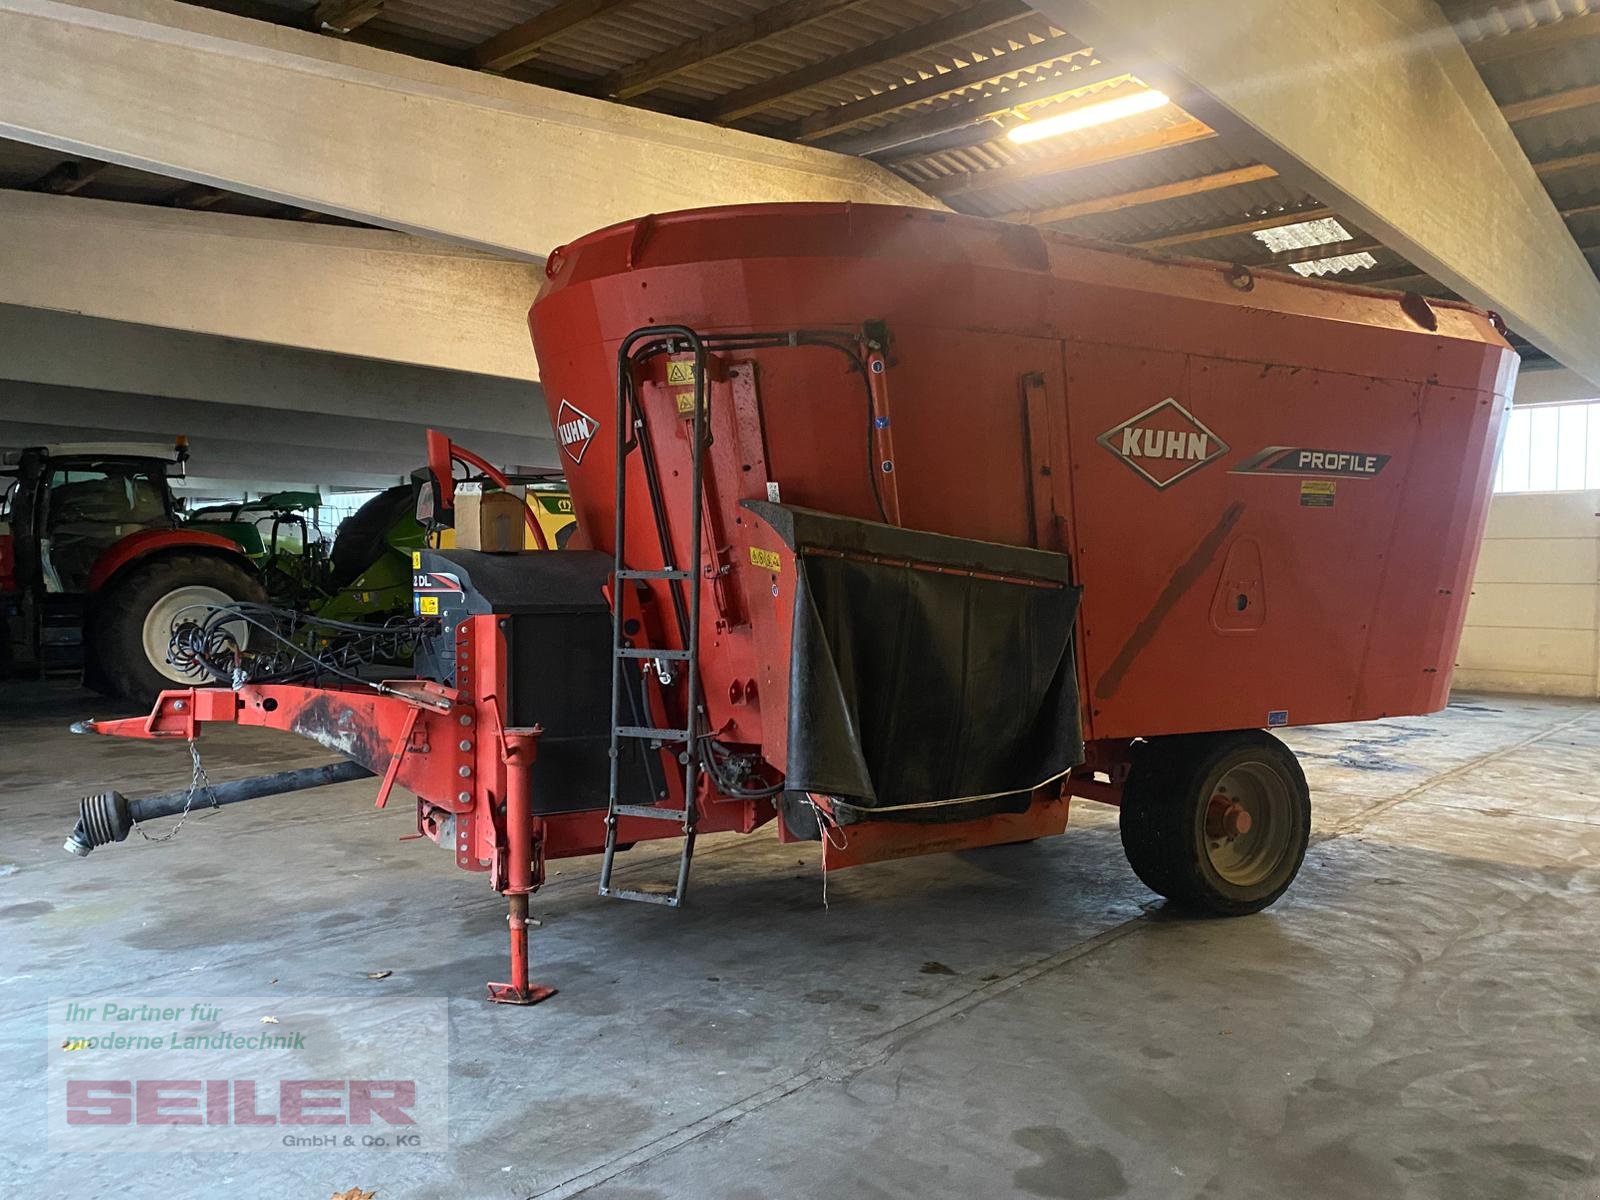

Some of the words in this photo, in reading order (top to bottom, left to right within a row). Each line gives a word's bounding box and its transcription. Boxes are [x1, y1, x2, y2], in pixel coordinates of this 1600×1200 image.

[559, 417, 590, 445] KUHN
[1122, 427, 1208, 460] KUHN
[1299, 451, 1377, 473] PROFILE
[418, 575, 432, 587] DL
